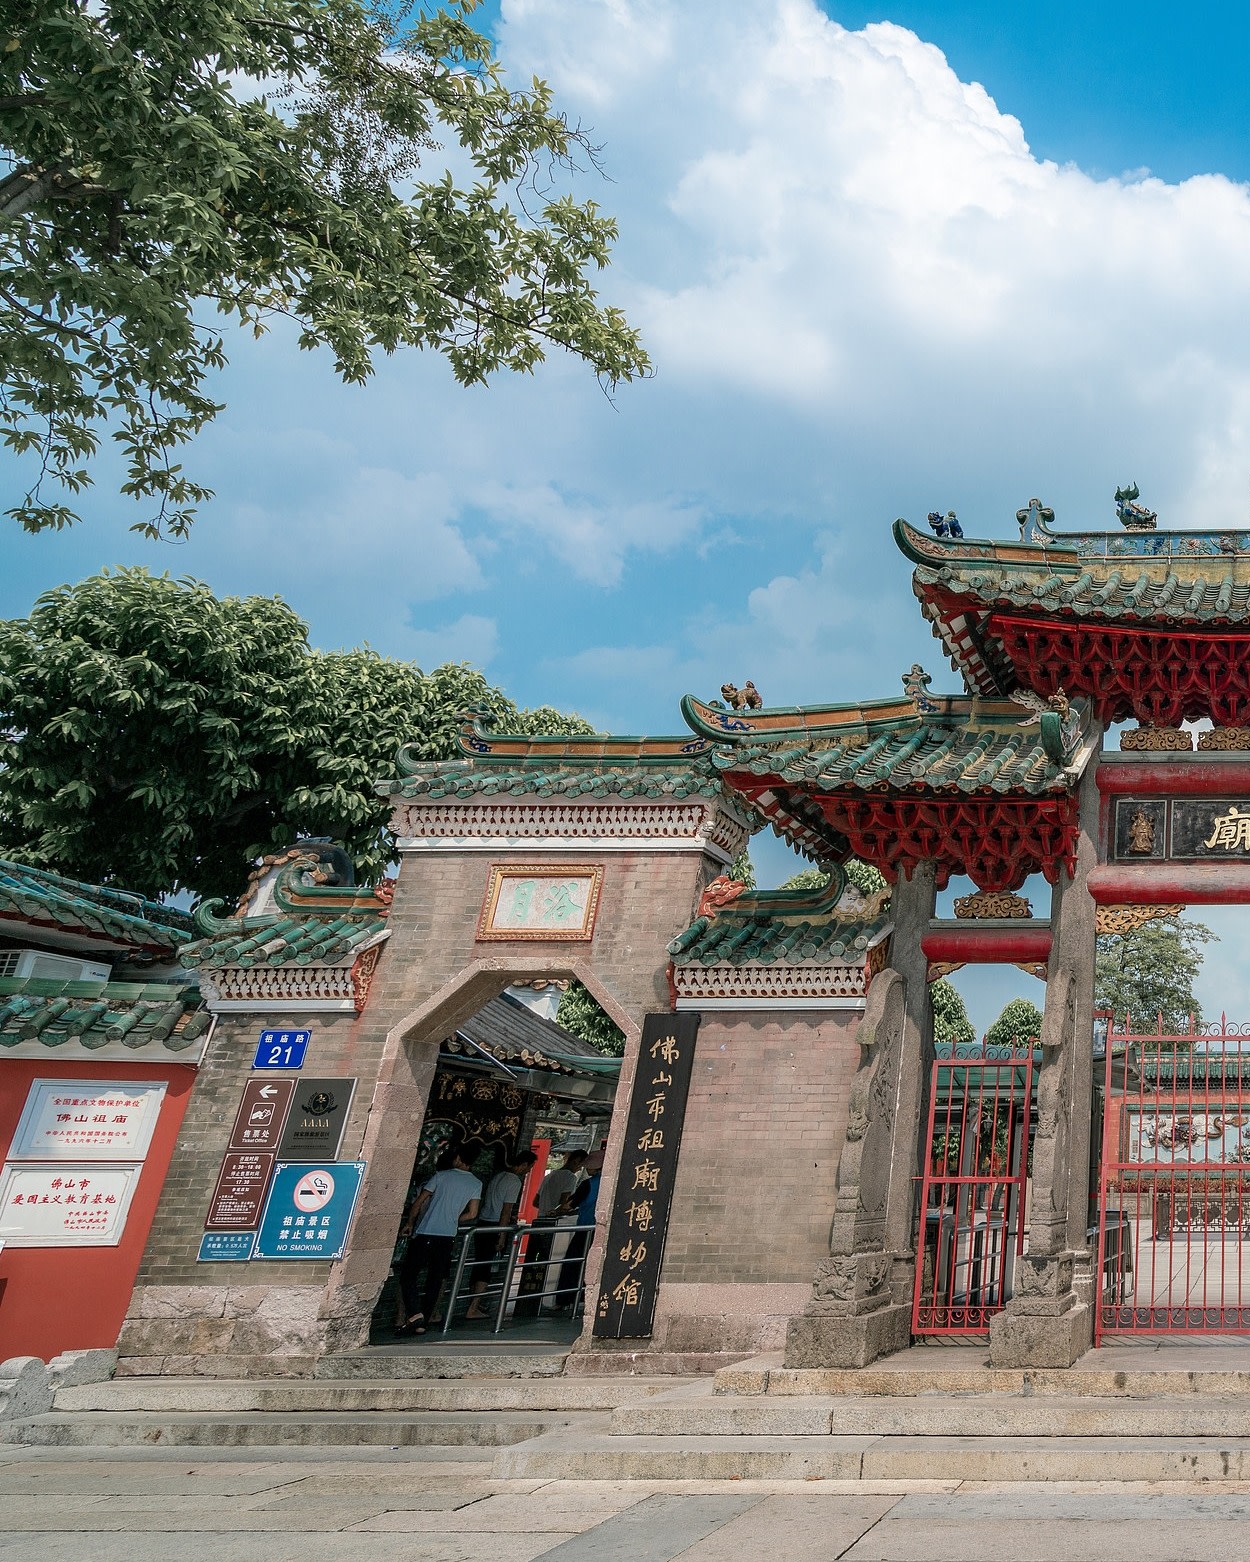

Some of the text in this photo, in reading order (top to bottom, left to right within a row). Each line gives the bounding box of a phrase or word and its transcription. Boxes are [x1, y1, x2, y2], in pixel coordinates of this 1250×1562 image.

[265, 1034, 304, 1043] 祖庙路
[267, 1046, 292, 1064] 21
[53, 1098, 140, 1107] 全国重点文物保护单位
[56, 1113, 128, 1123] 佛山祖庙
[243, 1129, 270, 1138] 售票处
[51, 1177, 90, 1190] 佛山市
[11, 1193, 116, 1205] 爱国主义教育基地
[282, 1215, 331, 1226] 祖庙景区
[279, 1229, 328, 1240] 禁止吸烟
